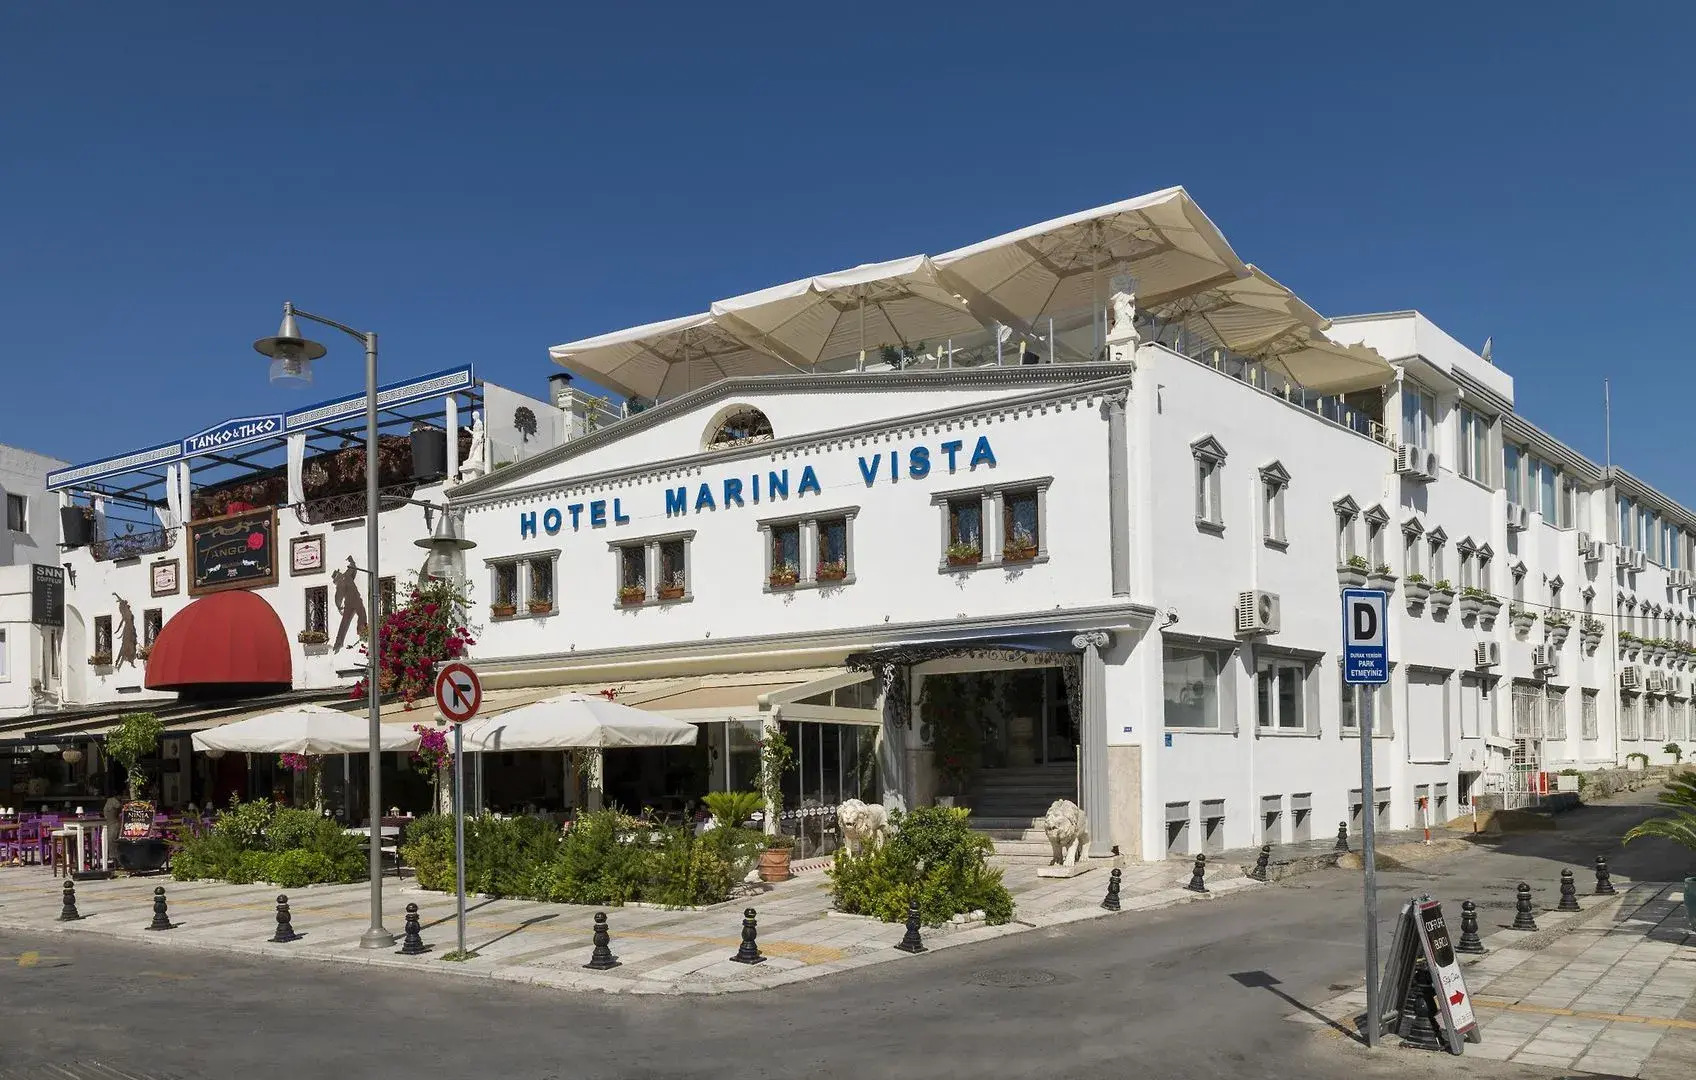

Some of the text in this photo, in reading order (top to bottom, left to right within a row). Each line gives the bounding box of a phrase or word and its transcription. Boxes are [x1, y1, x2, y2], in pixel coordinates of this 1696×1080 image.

[520, 435, 997, 538] HOTEL MARINA VISTA
[199, 538, 248, 564] TANGO
[36, 566, 63, 578] SNN
[1354, 603, 1377, 640] D
[1350, 668, 1382, 676] ETMEYİNİZ
